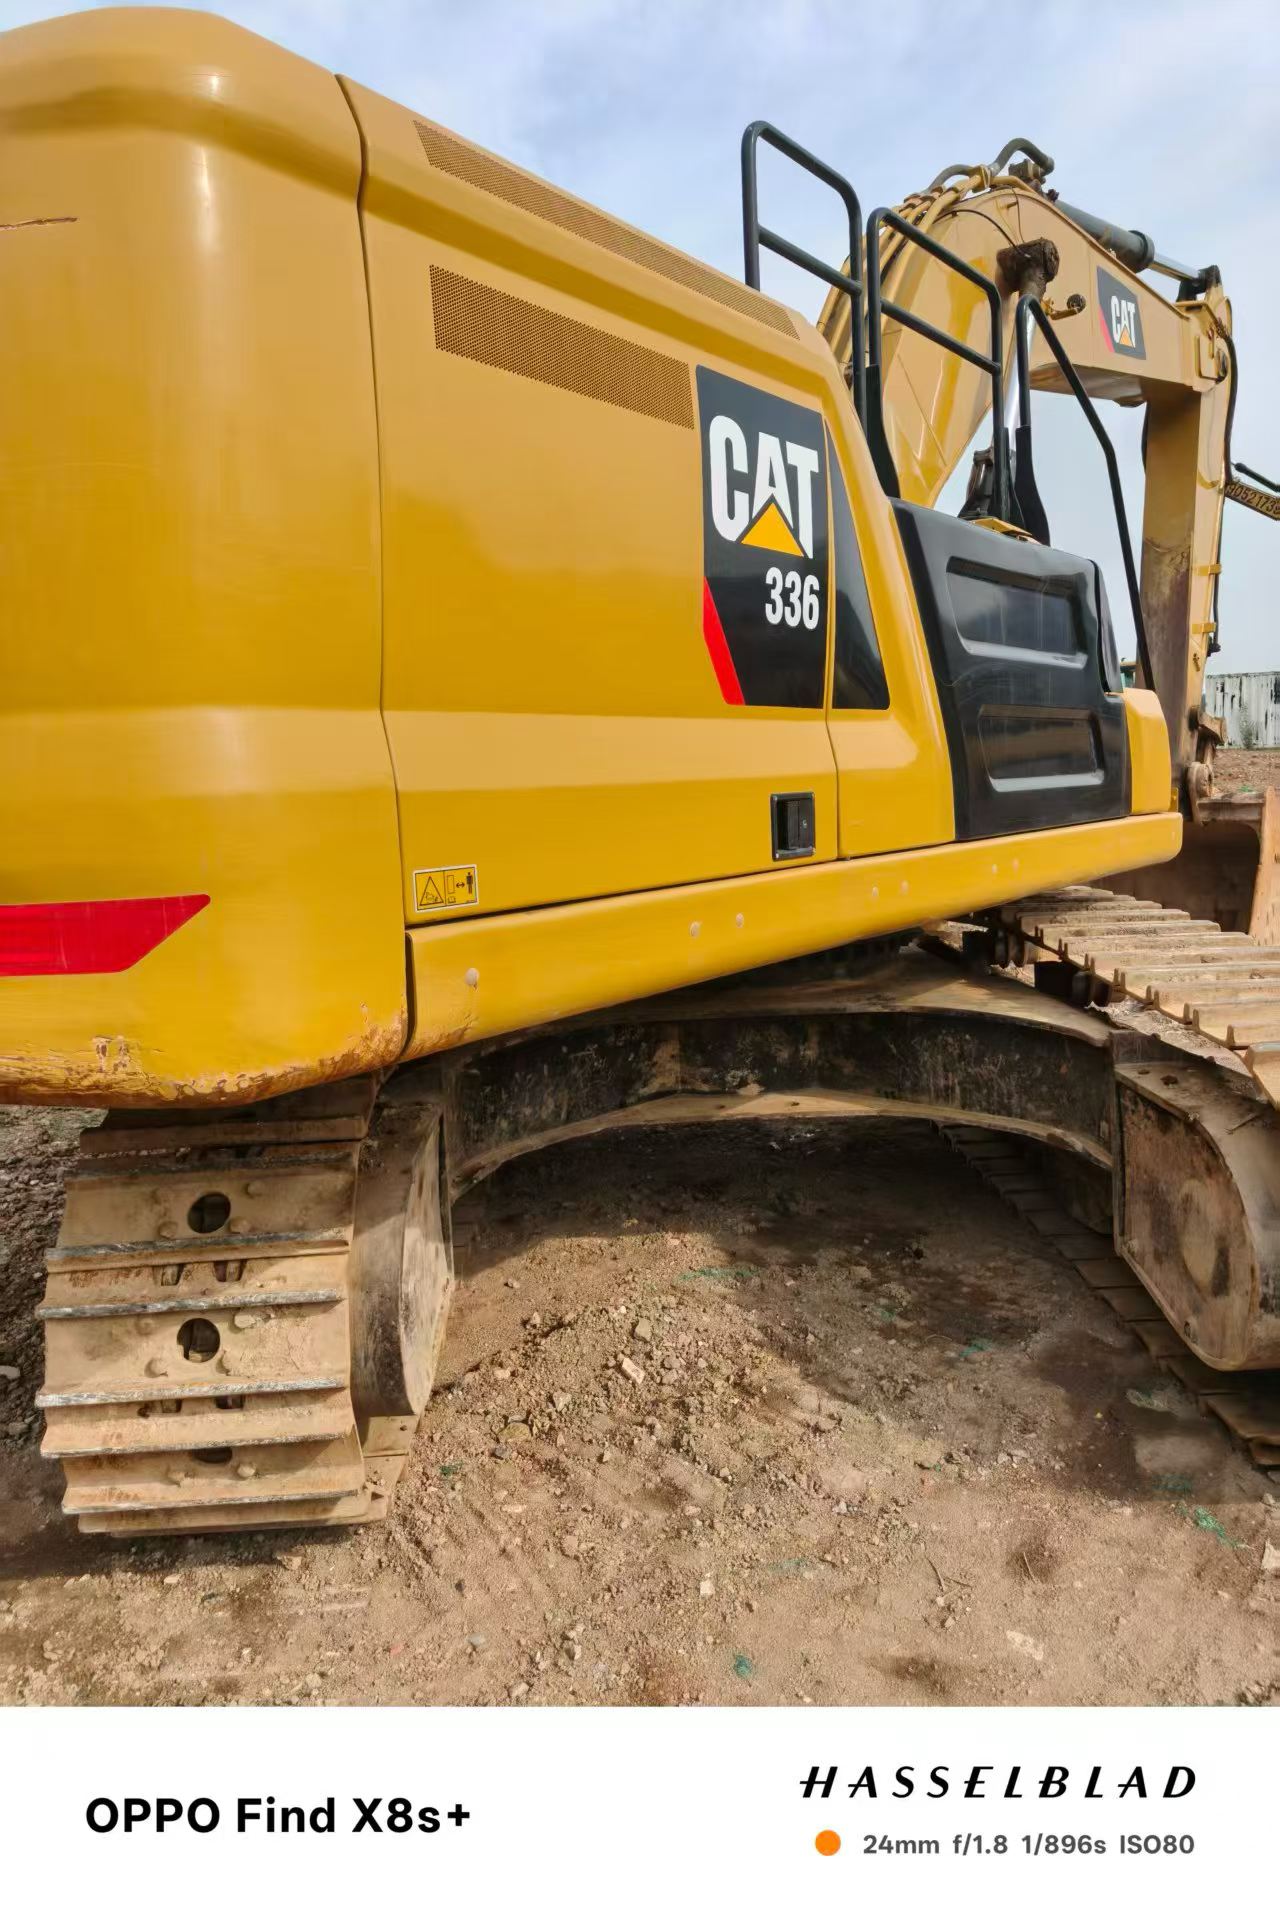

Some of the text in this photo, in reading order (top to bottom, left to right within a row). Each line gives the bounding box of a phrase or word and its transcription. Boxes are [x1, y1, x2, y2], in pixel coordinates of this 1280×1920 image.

[1111, 295, 1136, 348] CAT
[709, 415, 819, 559] CAT
[764, 566, 820, 630] 336
